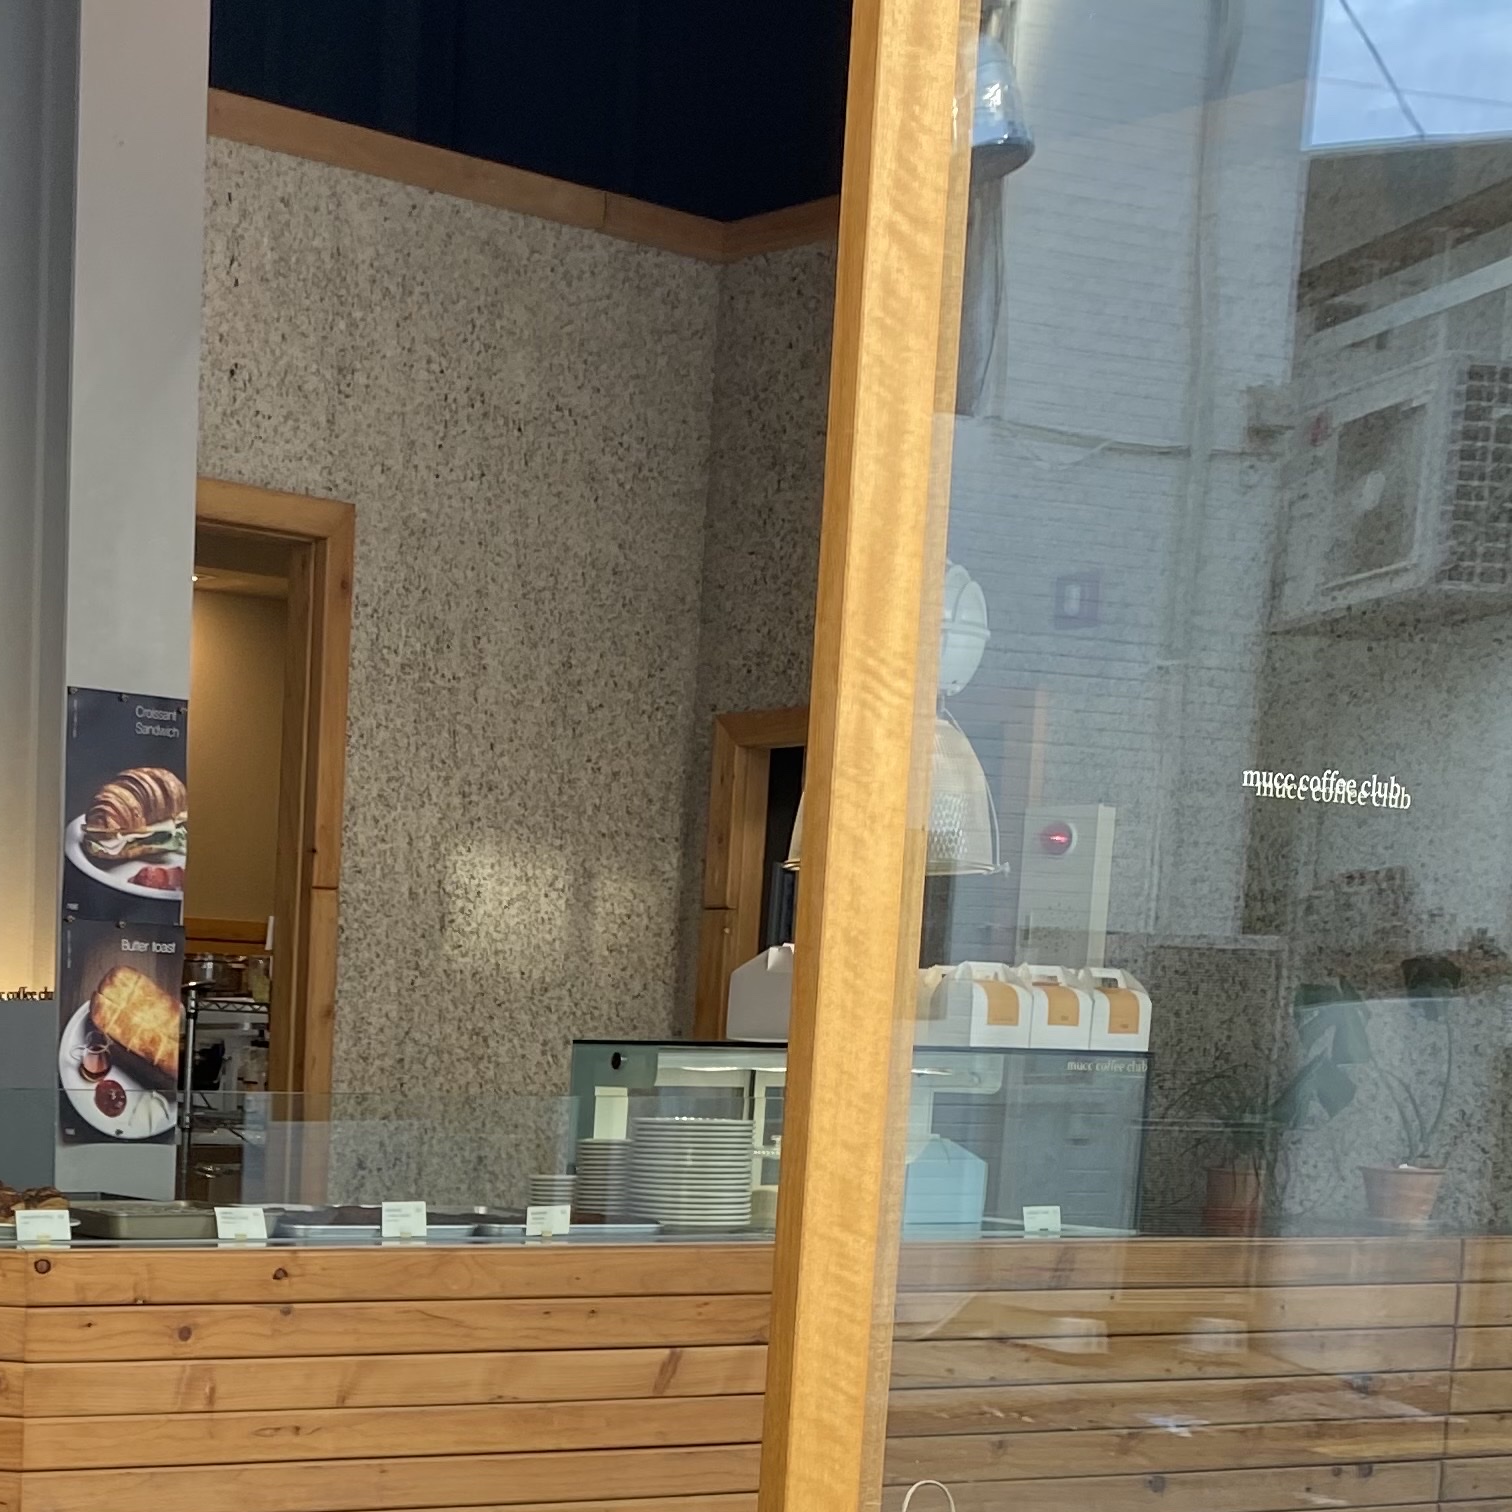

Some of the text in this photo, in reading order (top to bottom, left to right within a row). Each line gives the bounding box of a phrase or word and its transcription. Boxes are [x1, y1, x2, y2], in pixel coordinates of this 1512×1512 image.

[134, 705, 177, 721] Croissant
[134, 722, 180, 738] Sandwich
[1242, 769, 1401, 798] mucc coffee club
[121, 938, 176, 953] Butter toast
[1067, 1059, 1148, 1073] mucc coffee club
